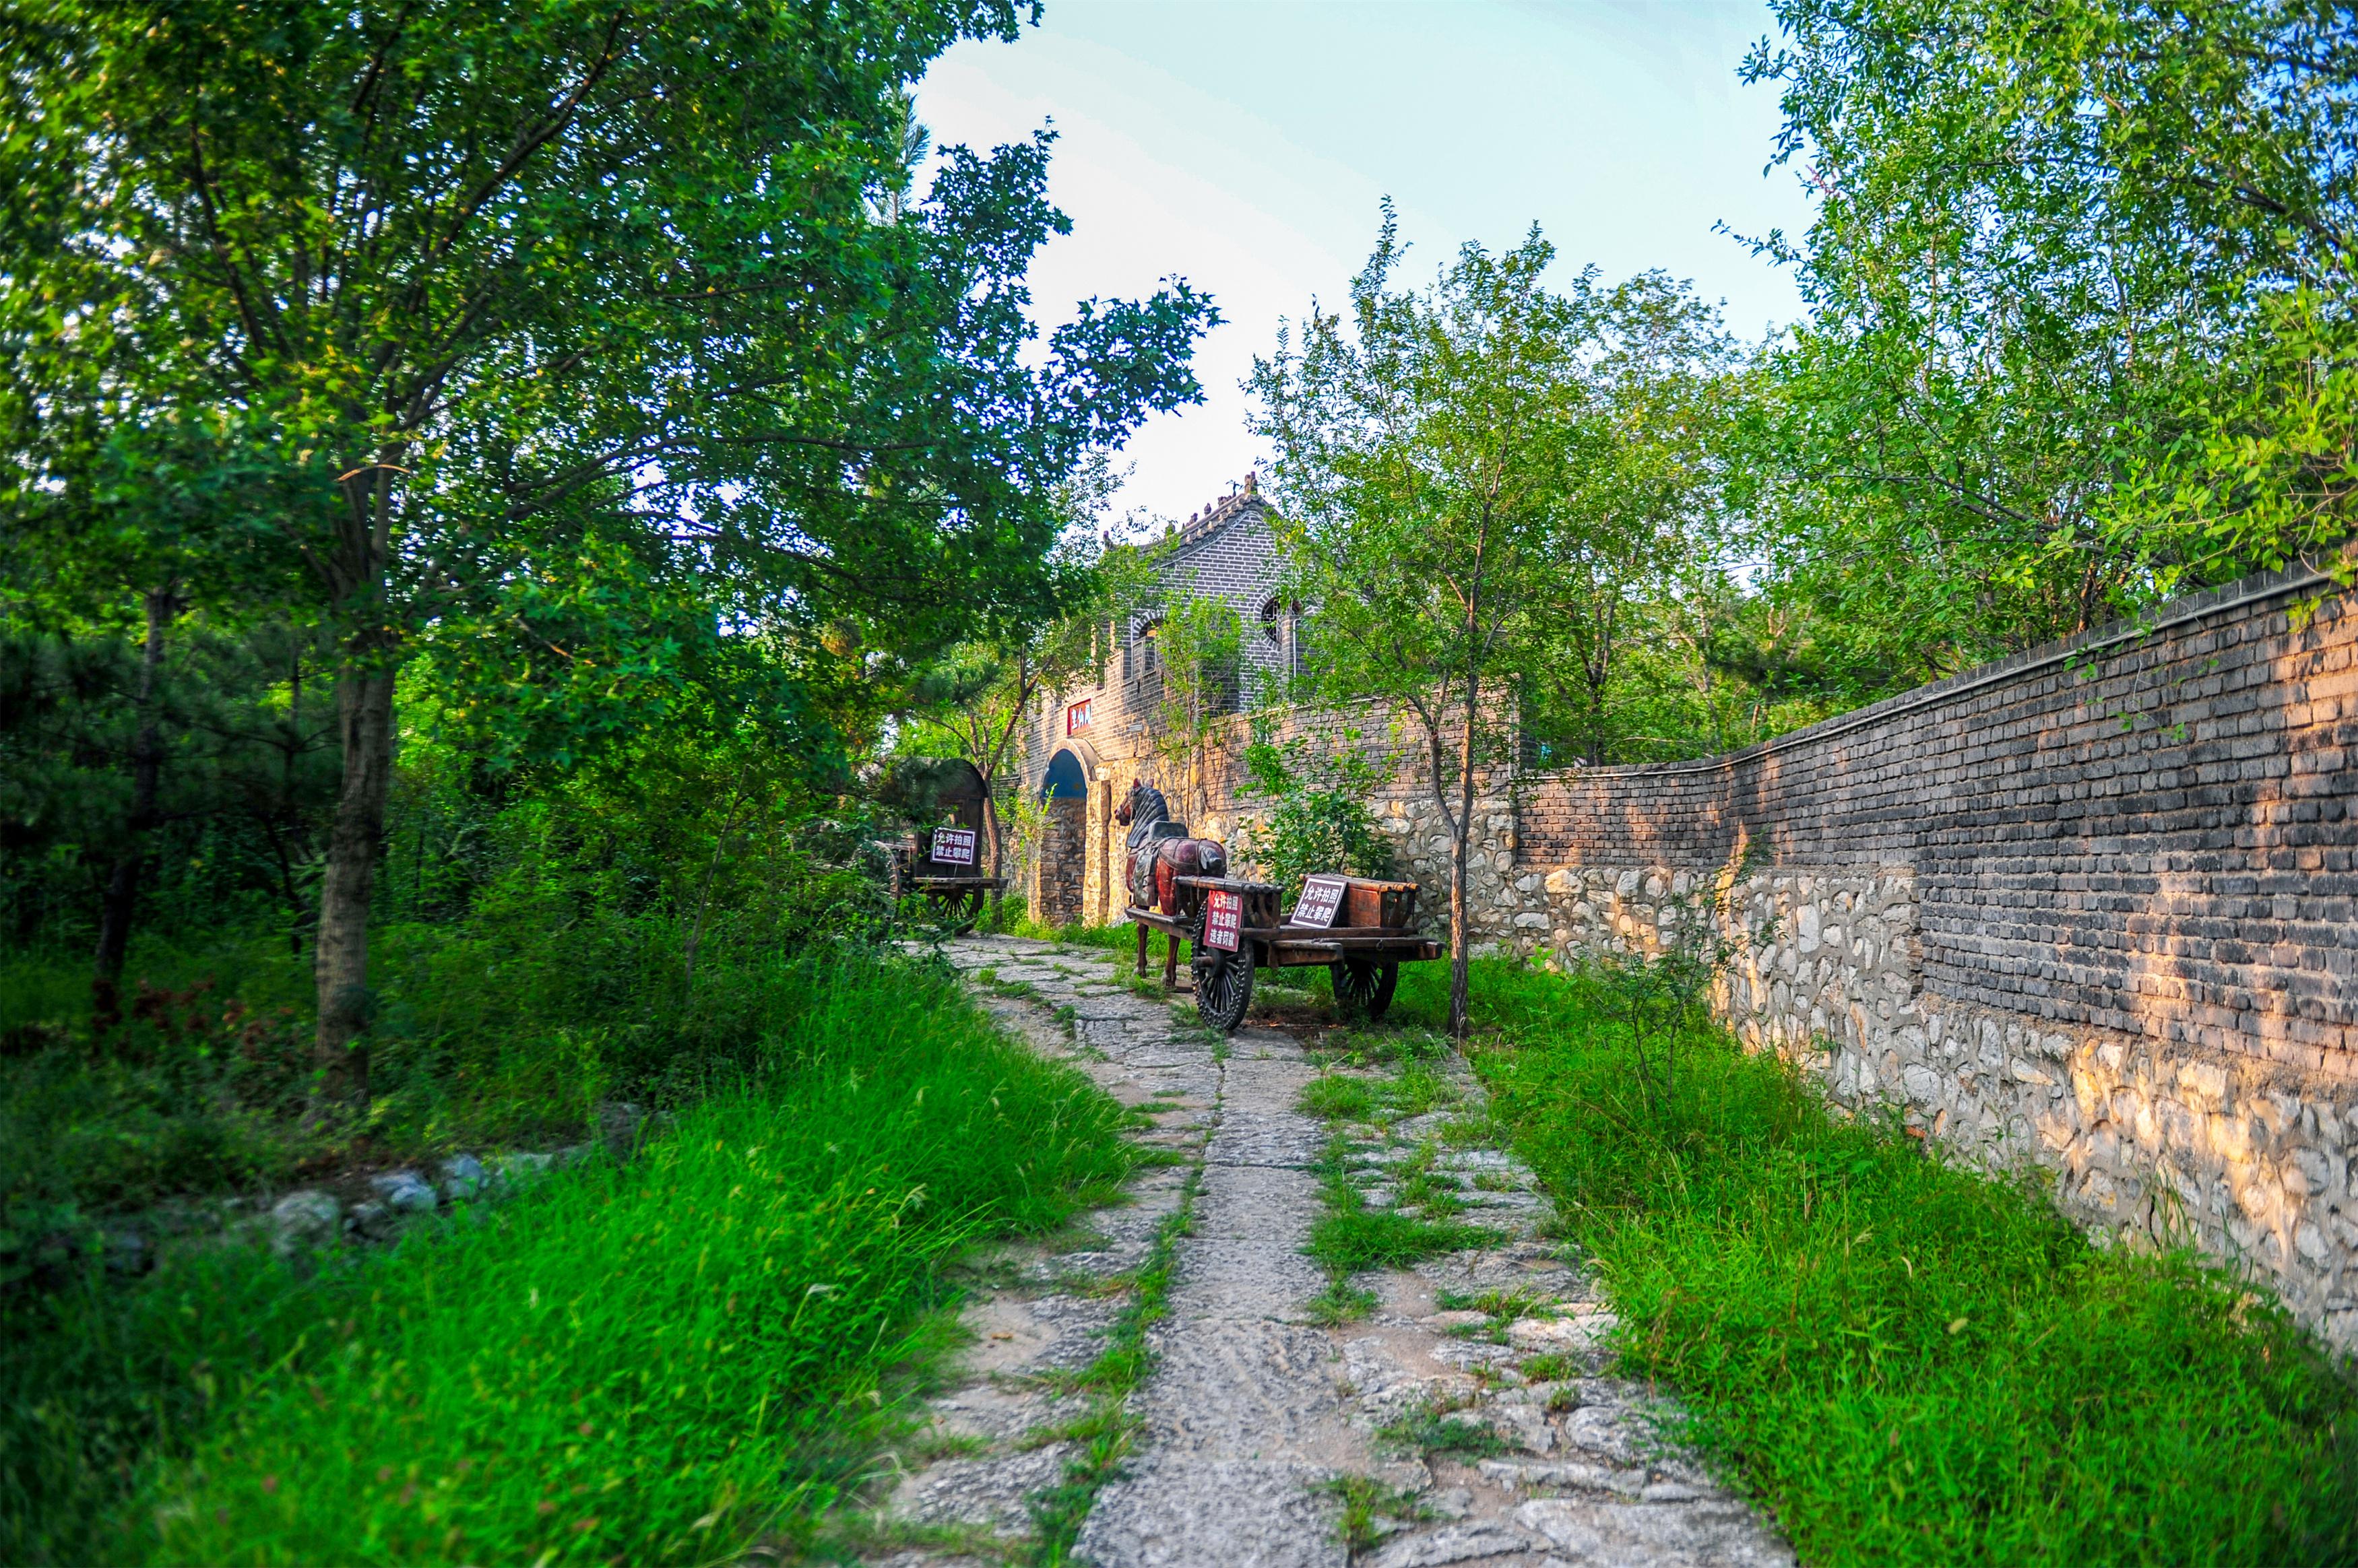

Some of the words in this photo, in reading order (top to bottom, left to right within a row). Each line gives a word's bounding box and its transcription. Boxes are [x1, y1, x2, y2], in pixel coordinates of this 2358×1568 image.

[937, 832, 971, 846] 允许拍照
[936, 845, 970, 859] 禁止攀爬
[1213, 893, 1238, 911] 允许拍照
[1304, 885, 1339, 904] 允许拍照
[1211, 911, 1237, 929] 禁止攀爬
[1297, 903, 1332, 922] 禁止攀爬
[1209, 929, 1235, 947] 违者罚款
